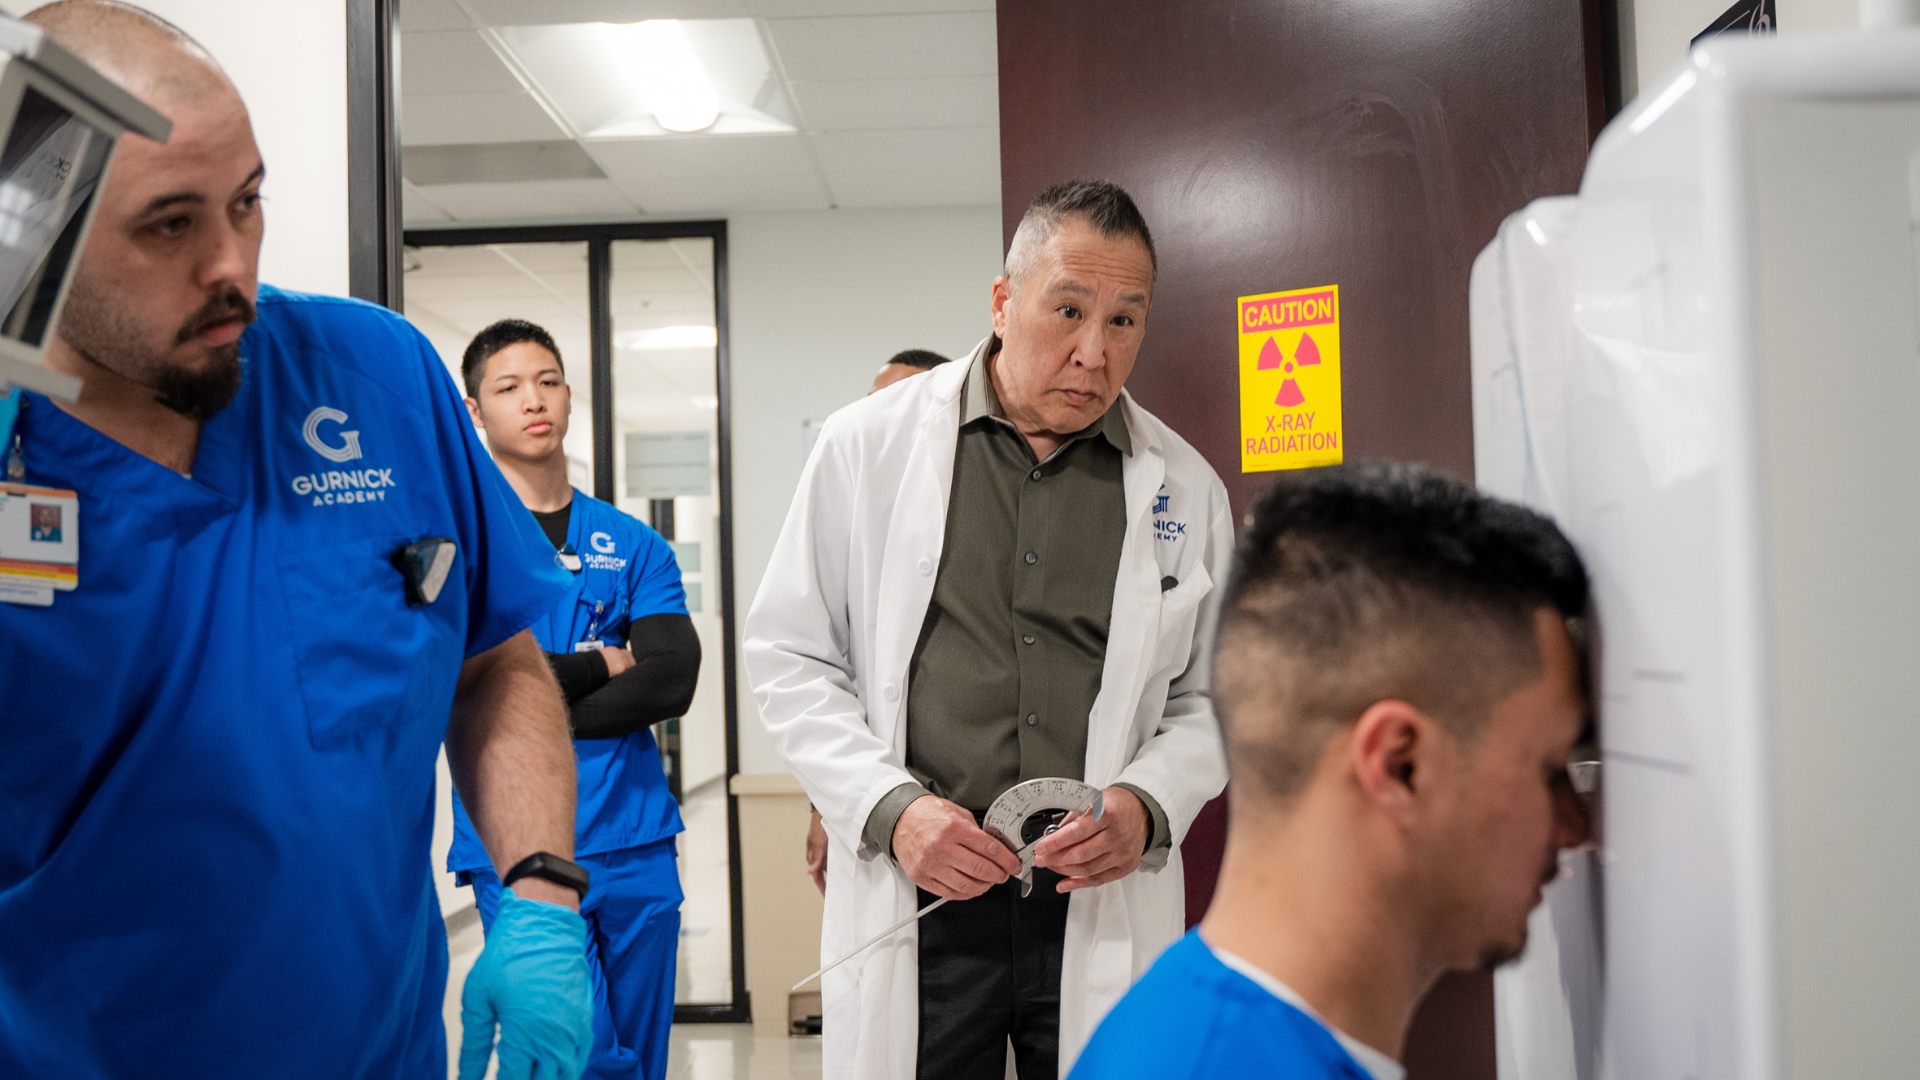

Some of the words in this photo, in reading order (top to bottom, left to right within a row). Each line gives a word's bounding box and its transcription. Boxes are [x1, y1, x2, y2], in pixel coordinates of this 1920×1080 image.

[1244, 297, 1332, 328] CAUTION
[1265, 411, 1316, 434] X-RAY
[1245, 431, 1337, 456] RADIATION
[291, 467, 396, 496] GURNICK
[312, 489, 386, 507] ACADEMY
[1153, 532, 1178, 542] EMY
[589, 562, 621, 572] ACADE
